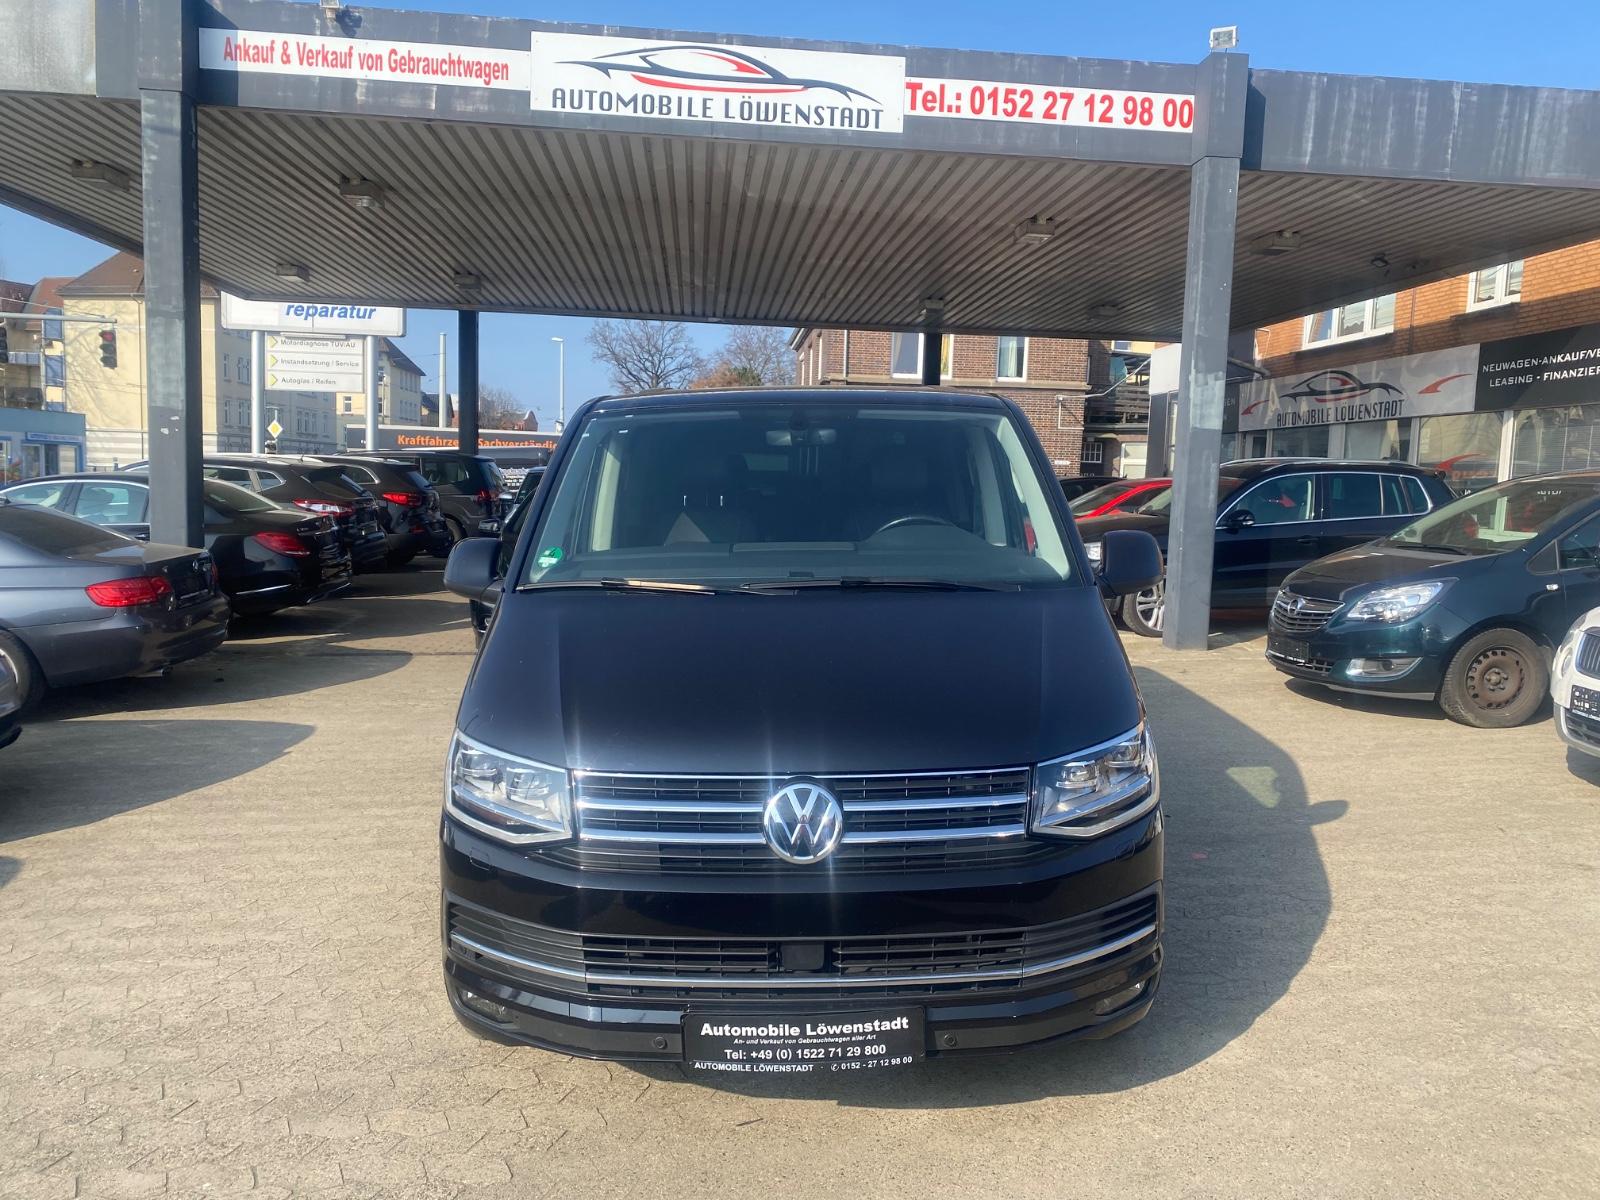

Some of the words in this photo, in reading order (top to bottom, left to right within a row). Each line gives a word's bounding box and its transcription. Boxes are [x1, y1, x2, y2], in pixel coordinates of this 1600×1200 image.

[223, 36, 276, 64] Ankauf
[281, 41, 291, 65] &
[296, 41, 353, 69] Verkauf
[358, 52, 383, 72] von
[388, 48, 509, 86] Gebrauchtwagen
[552, 87, 713, 119] AUTOMOBILE
[724, 95, 884, 129] LÖWENSTADT
[905, 82, 962, 114] Tel.:
[970, 85, 1034, 119] 0152
[1042, 91, 1075, 121] 27
[1084, 93, 1114, 123] 12
[1123, 95, 1154, 126] 98
[1163, 98, 1194, 129] 00
[285, 304, 377, 320] reparatur
[280, 358, 330, 368] Instandsetzung
[281, 376, 311, 385] Autoglas
[1489, 374, 1533, 388] LEASING
[1276, 408, 1331, 427] AUTOMOBILE
[1335, 400, 1405, 421] LÖWENSTADT
[397, 434, 459, 447] Kraftfahrze
[701, 1023, 800, 1036] Automobile
[806, 1017, 909, 1036] Löwenstadt
[724, 1050, 747, 1060] Tel:
[750, 1049, 773, 1060] +49
[776, 1048, 792, 1060] (0)
[796, 1048, 825, 1059] 1522
[828, 1048, 843, 1058] 71
[846, 1047, 861, 1056] 29
[864, 1044, 887, 1055] 800
[694, 1062, 752, 1072] AUTOMOBILE
[753, 1063, 814, 1072] LÖWENSTADT
[841, 1062, 861, 1070] 0152
[867, 1060, 877, 1068] 27
[879, 1059, 890, 1067] 12
[902, 1056, 913, 1064] 00
